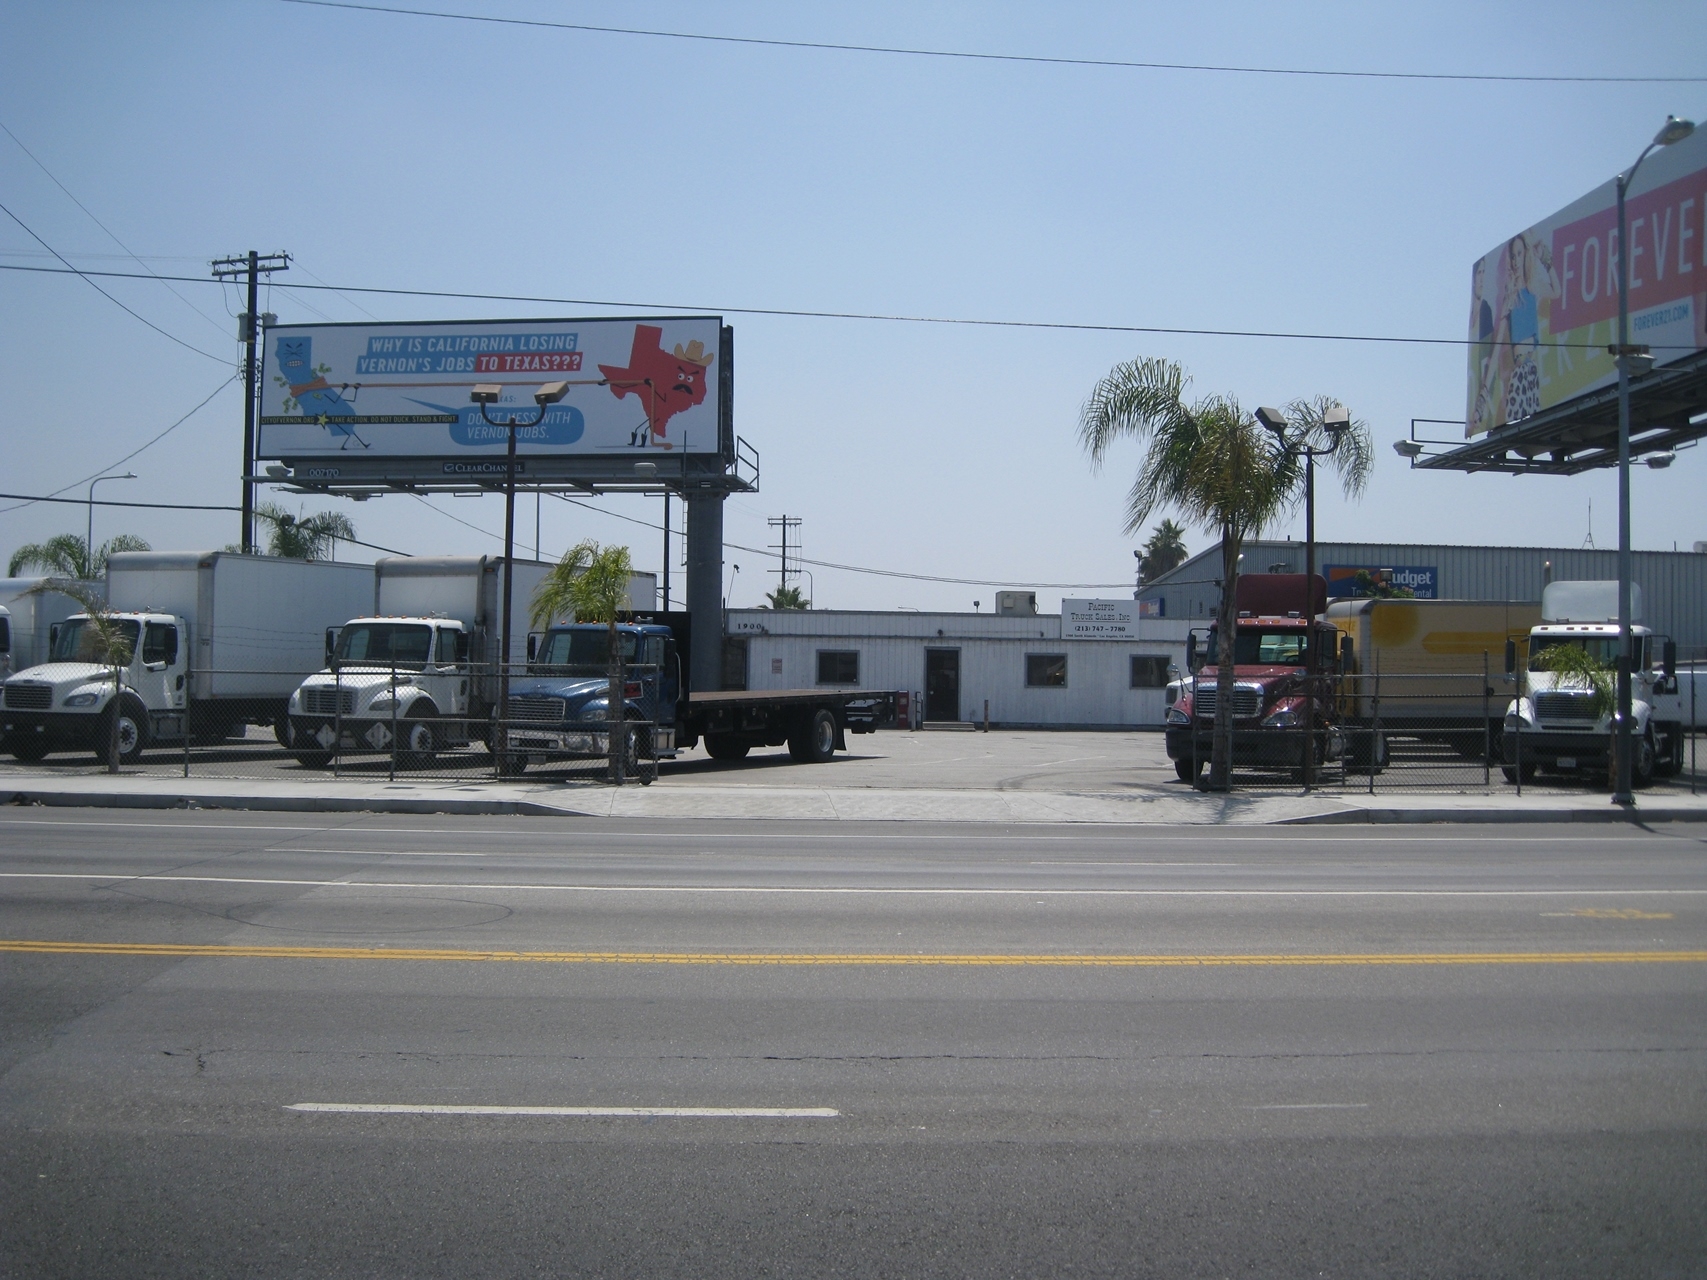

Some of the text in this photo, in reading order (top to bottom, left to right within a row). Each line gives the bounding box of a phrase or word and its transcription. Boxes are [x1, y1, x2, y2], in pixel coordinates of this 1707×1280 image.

[1560, 192, 1707, 311] FOREVE
[1633, 304, 1690, 331] FOREVER21.COM
[372, 335, 575, 353] WHY IS CALIFORNIA LOSING
[360, 354, 580, 372] VERNON'S JOBS TO TEXAS???
[467, 411, 571, 425] DON'T MESS WITH
[467, 426, 550, 439] VERNON JOBS.
[1388, 570, 1431, 587] udget
[1413, 589, 1432, 598] ental
